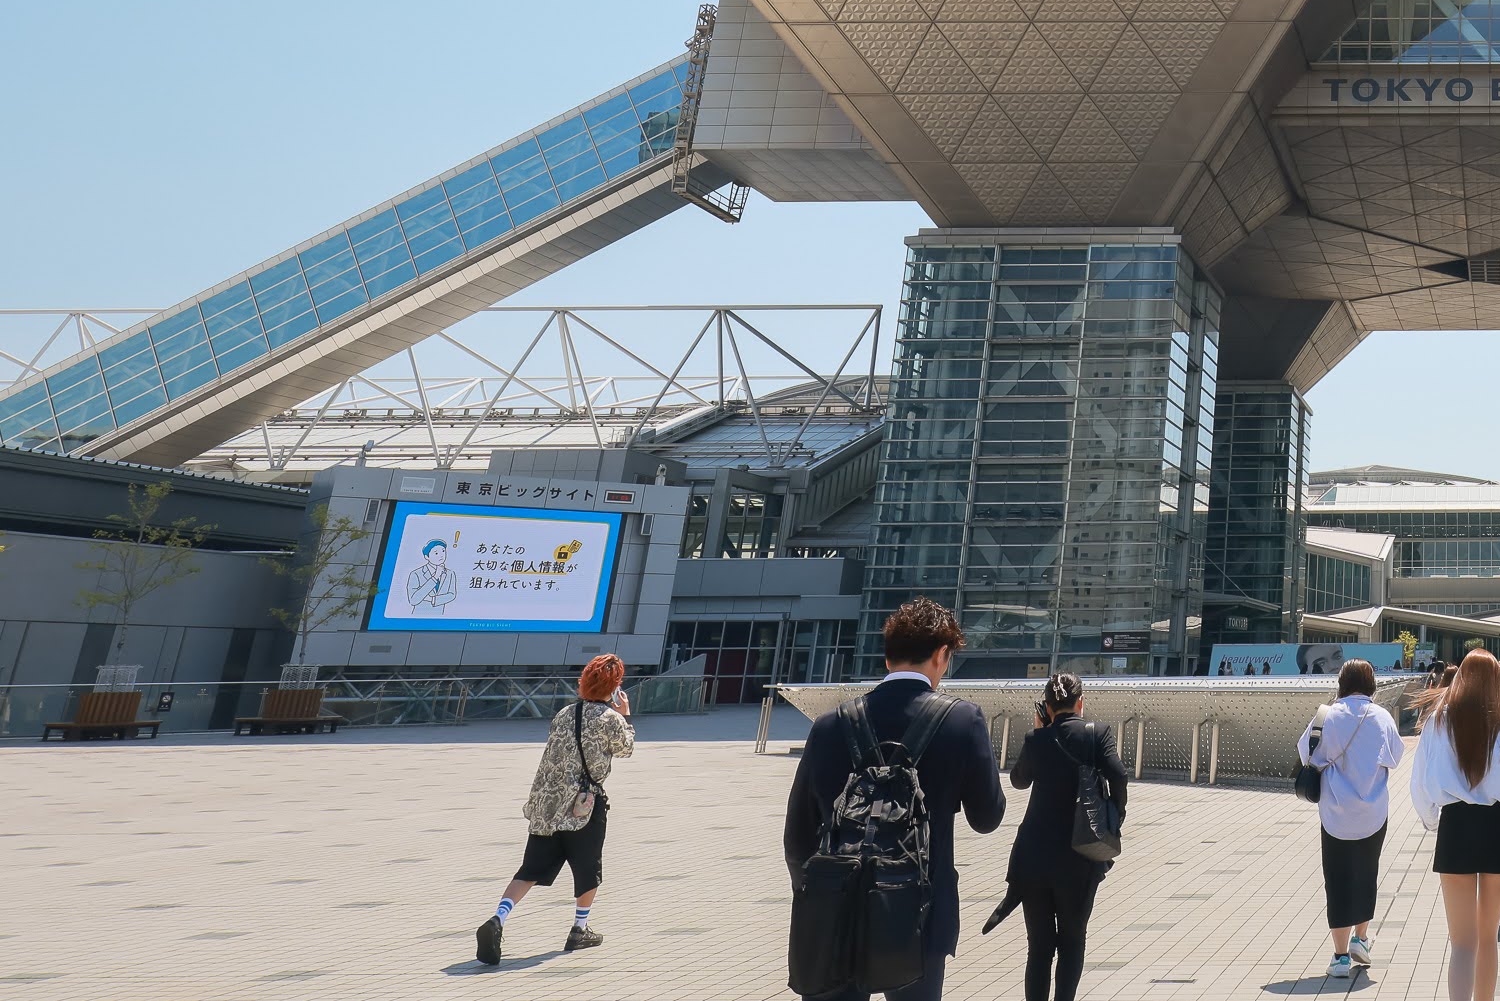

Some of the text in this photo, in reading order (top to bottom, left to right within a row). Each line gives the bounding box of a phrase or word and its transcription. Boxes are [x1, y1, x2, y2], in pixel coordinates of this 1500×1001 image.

[1322, 77, 1474, 102] TOKYO
[455, 481, 594, 501] 東京ビッグサイト
[476, 542, 525, 555] あなたの
[472, 559, 578, 574] 大切な個人情報が
[469, 576, 560, 592] 狙われています。
[1221, 653, 1284, 664] beautyworld
